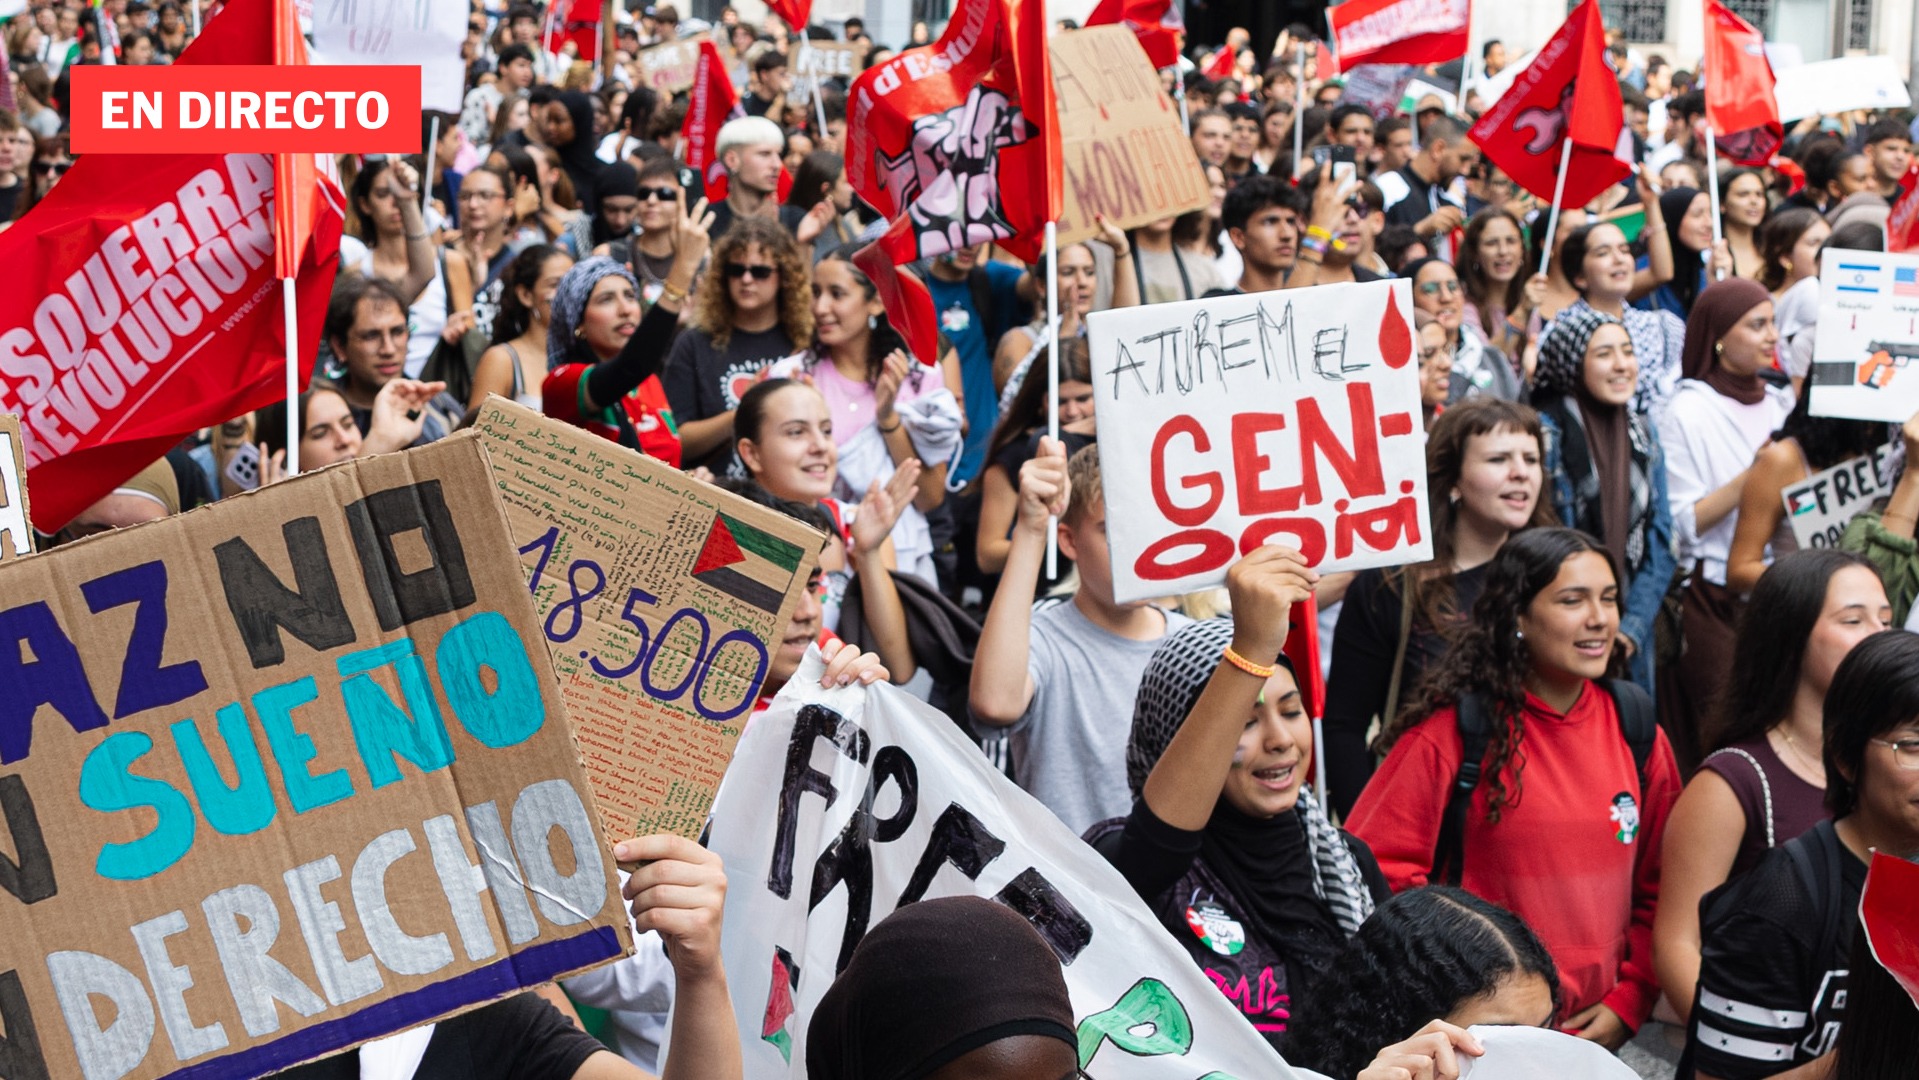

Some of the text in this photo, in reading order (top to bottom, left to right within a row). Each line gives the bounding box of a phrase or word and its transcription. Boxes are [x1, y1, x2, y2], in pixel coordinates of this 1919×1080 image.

[1106, 299, 1371, 400] ATUREM EL
[1150, 382, 1413, 527] GEN-
[212, 478, 476, 669] NO
[78, 611, 548, 882] SUEÑO
[46, 778, 611, 1080] DERECHO
